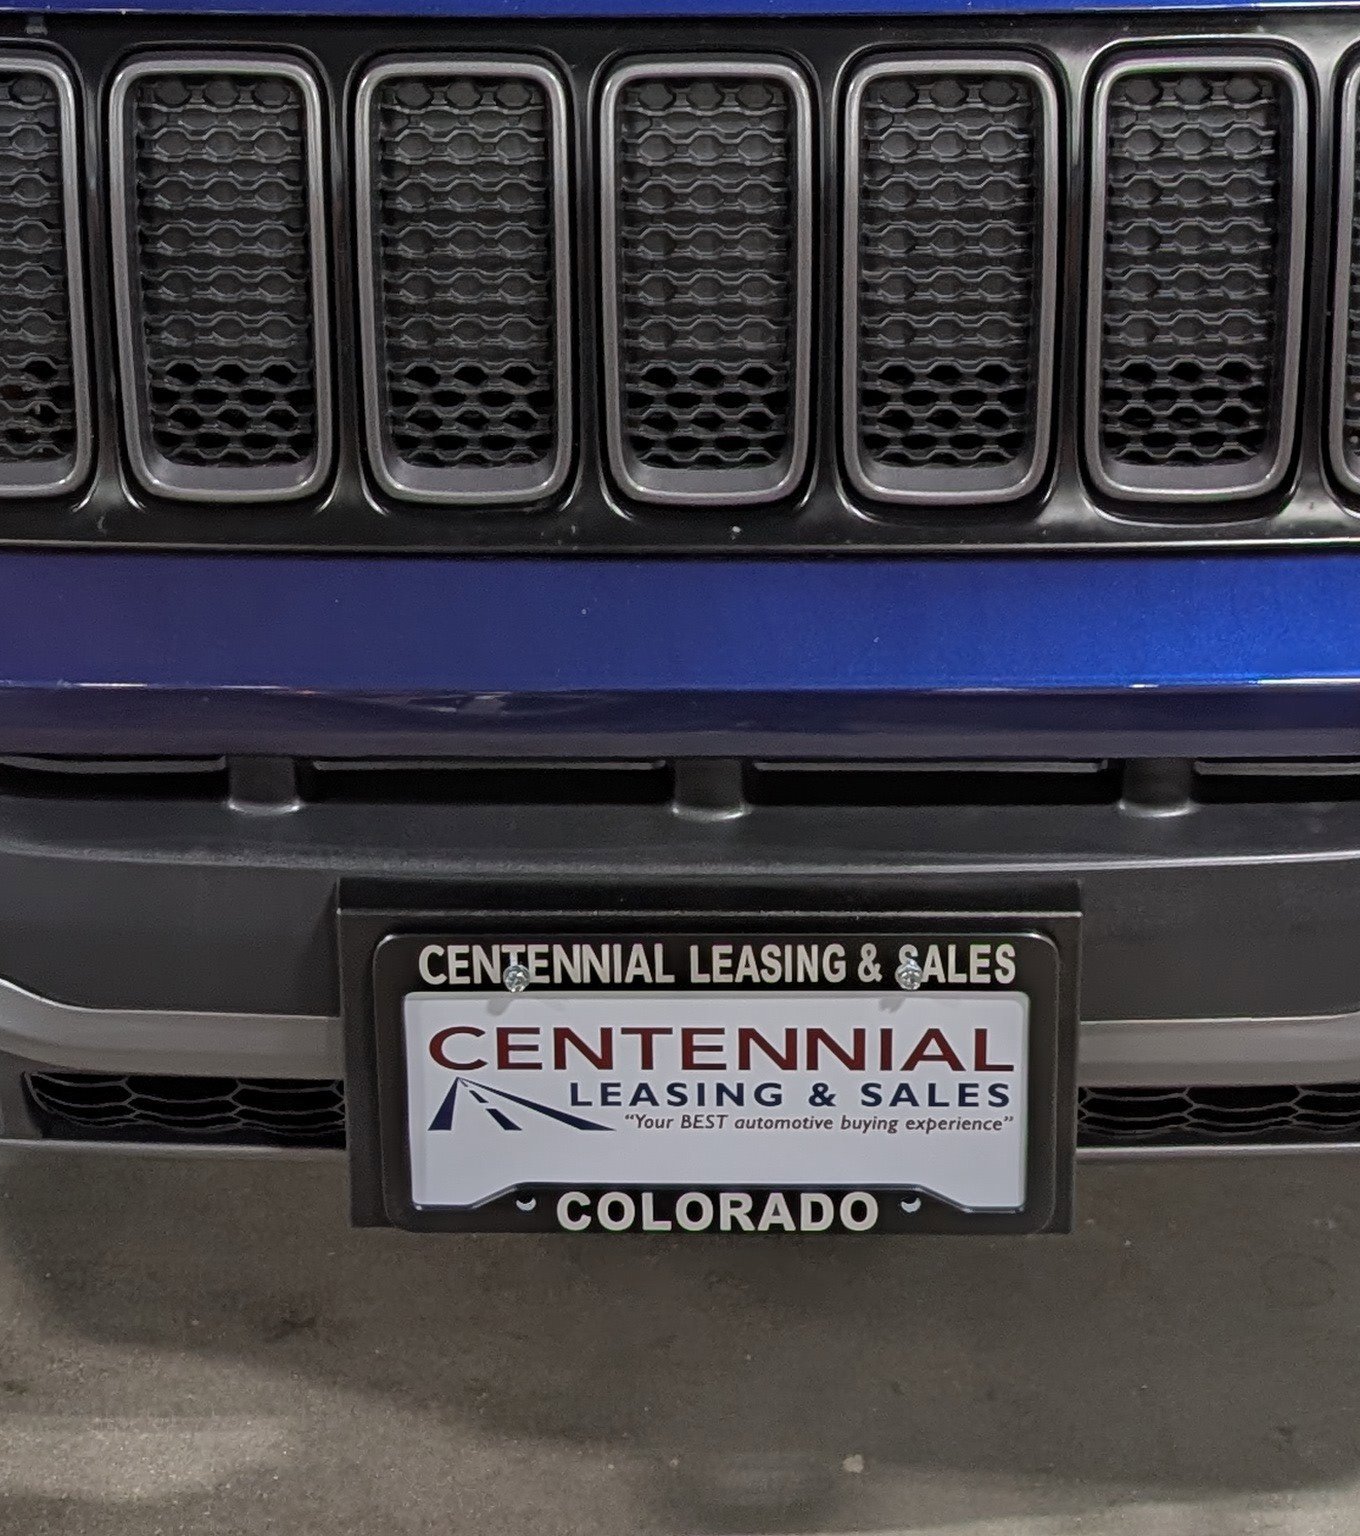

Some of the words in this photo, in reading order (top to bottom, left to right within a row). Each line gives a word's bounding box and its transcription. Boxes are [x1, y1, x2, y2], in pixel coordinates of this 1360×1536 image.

[418, 944, 675, 984] CENTENNIAL
[690, 944, 846, 984] LEASING
[857, 943, 883, 983] &
[429, 1026, 1014, 1072] CENTENNIAL
[570, 1082, 783, 1107] LEASING
[808, 1082, 836, 1107] &
[861, 1082, 1010, 1108] SALES
[625, 1114, 674, 1130] “Your
[680, 1115, 728, 1130] BEST
[734, 1115, 833, 1131] automotive
[840, 1115, 898, 1134] buying
[905, 1115, 1014, 1134] experience”
[556, 1191, 879, 1232] COLORADO
